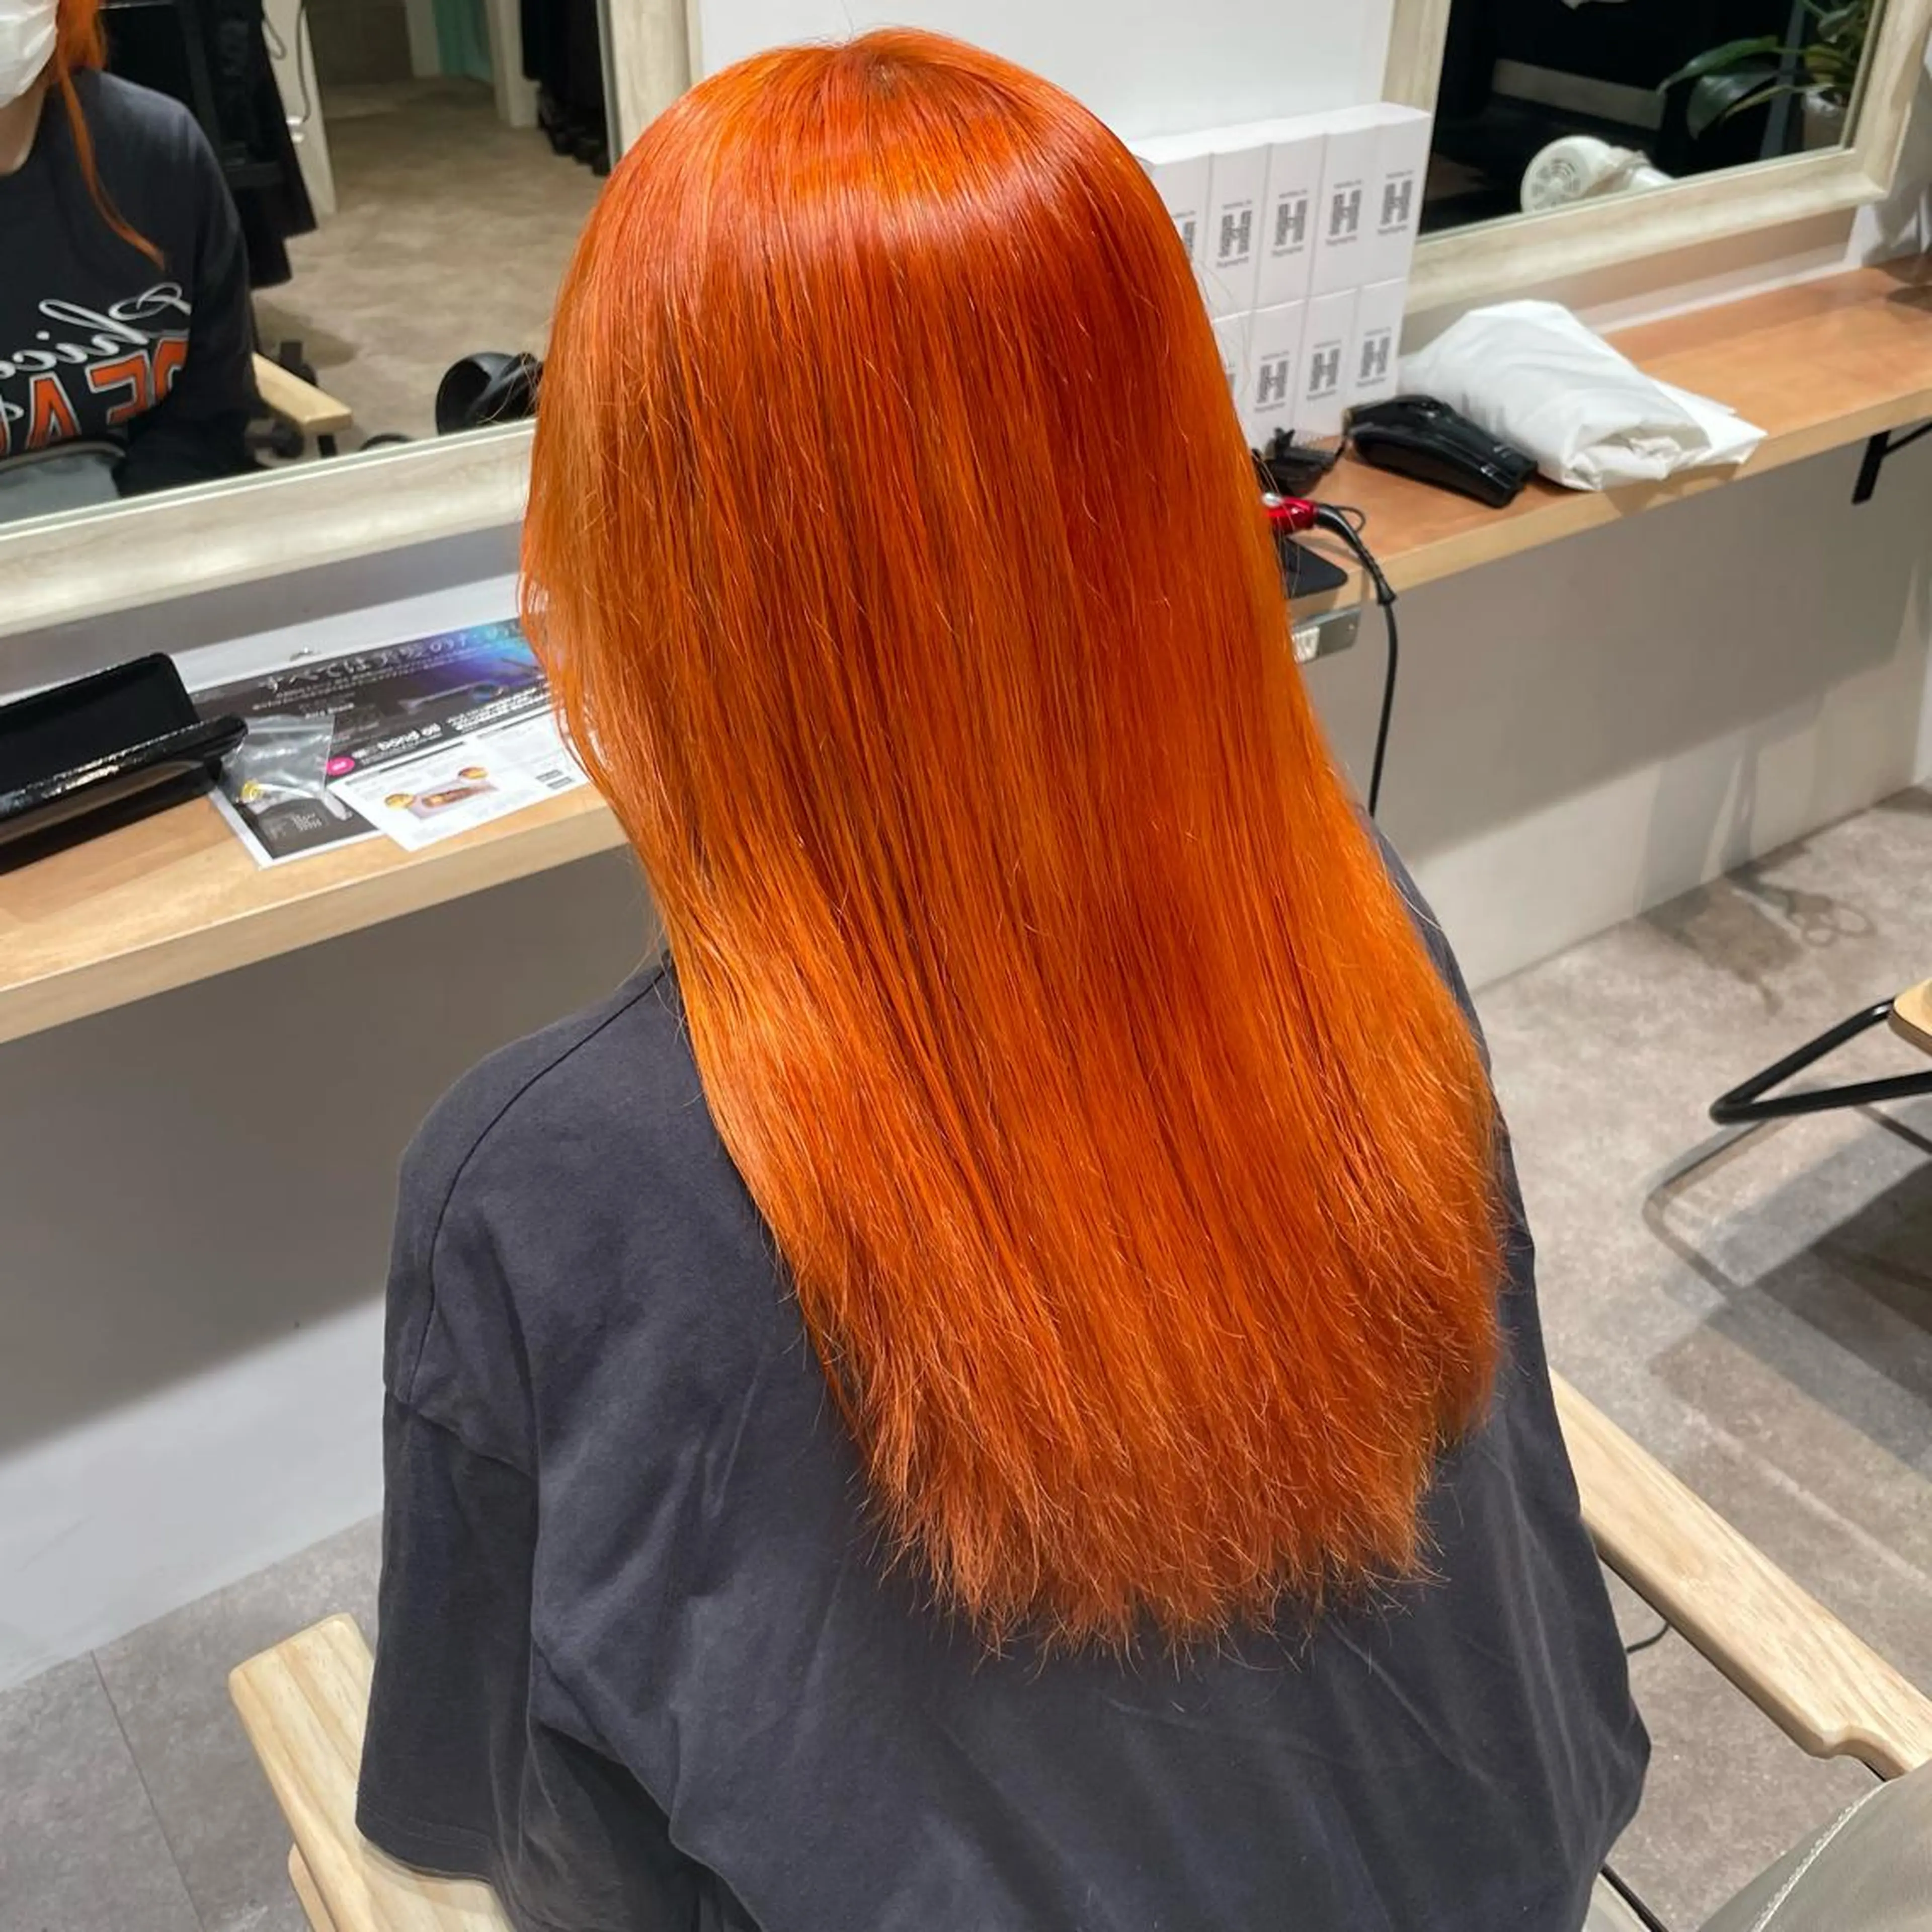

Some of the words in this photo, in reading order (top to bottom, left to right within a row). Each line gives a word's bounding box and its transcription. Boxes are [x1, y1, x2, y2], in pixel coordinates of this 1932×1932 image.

[1274, 200, 1307, 246] H
[1329, 190, 1361, 235] H
[1380, 180, 1413, 225] H
[1218, 211, 1252, 258] H
[1309, 349, 1339, 392] H
[1359, 337, 1391, 378] H
[1257, 360, 1289, 404] H
